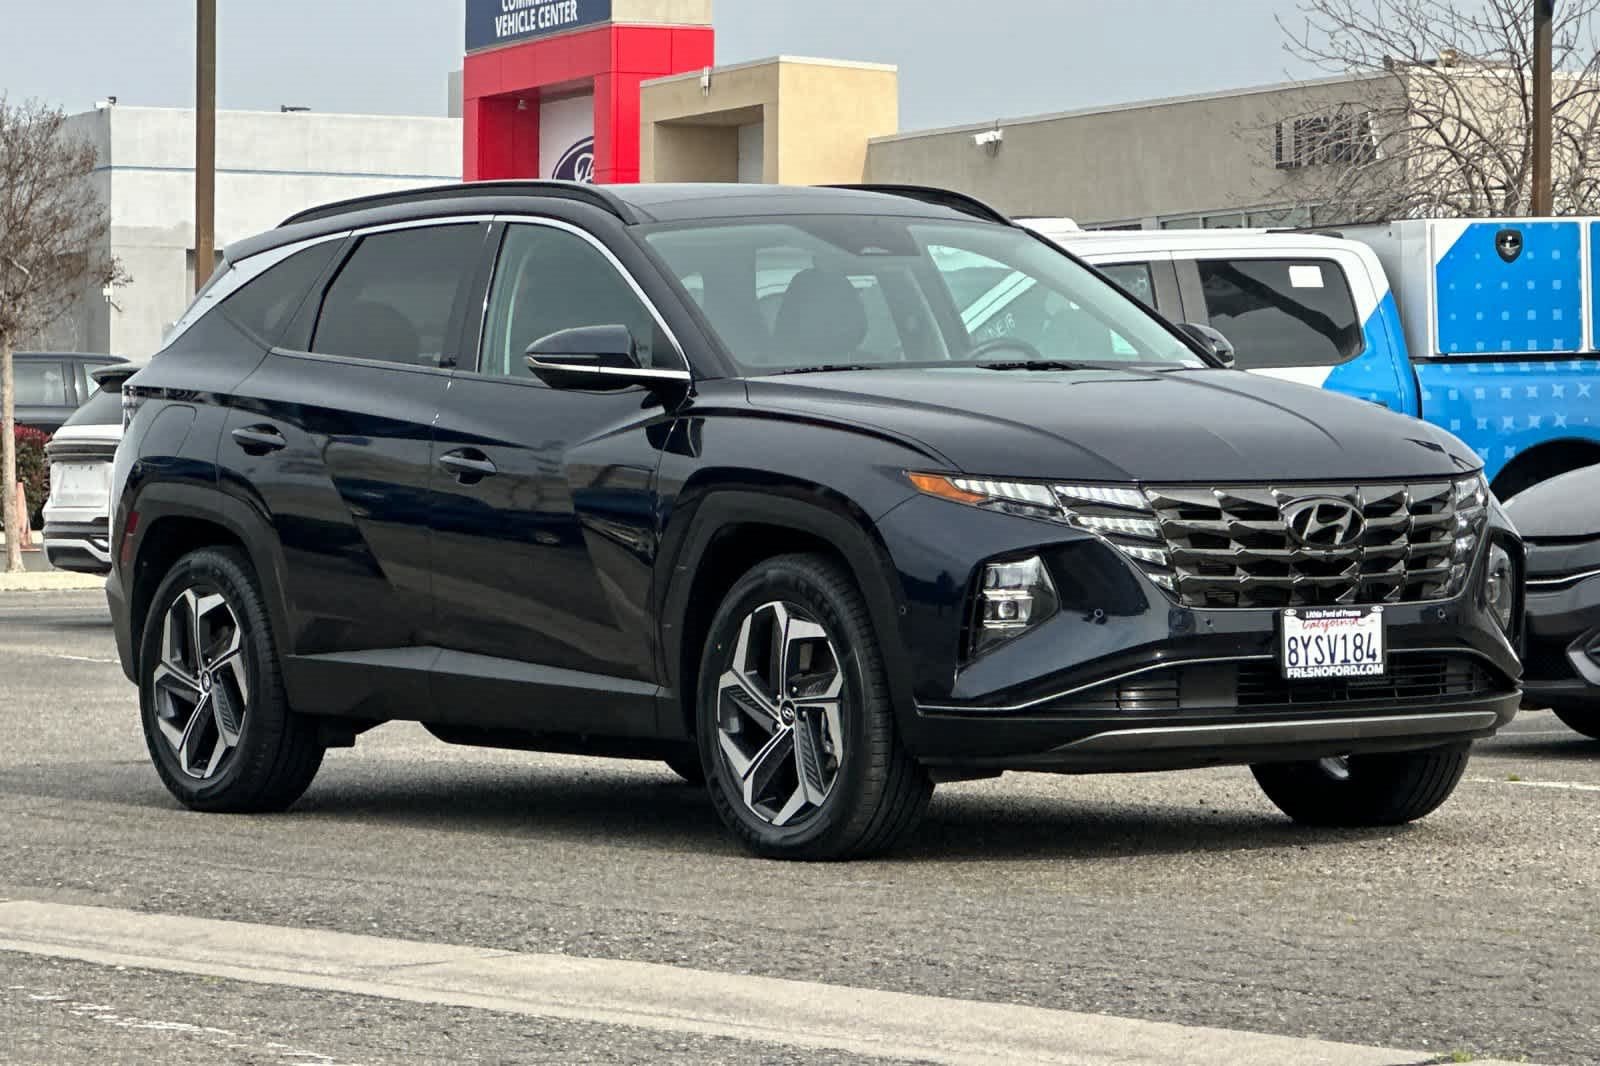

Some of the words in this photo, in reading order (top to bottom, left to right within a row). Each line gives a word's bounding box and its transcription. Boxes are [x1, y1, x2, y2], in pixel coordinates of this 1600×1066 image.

[495, 8, 536, 37] VEHICLE
[538, 0, 578, 29] CENTER
[1288, 632, 1377, 666] 8YSV184
[1287, 664, 1384, 678] FRESNOFORD.COM
